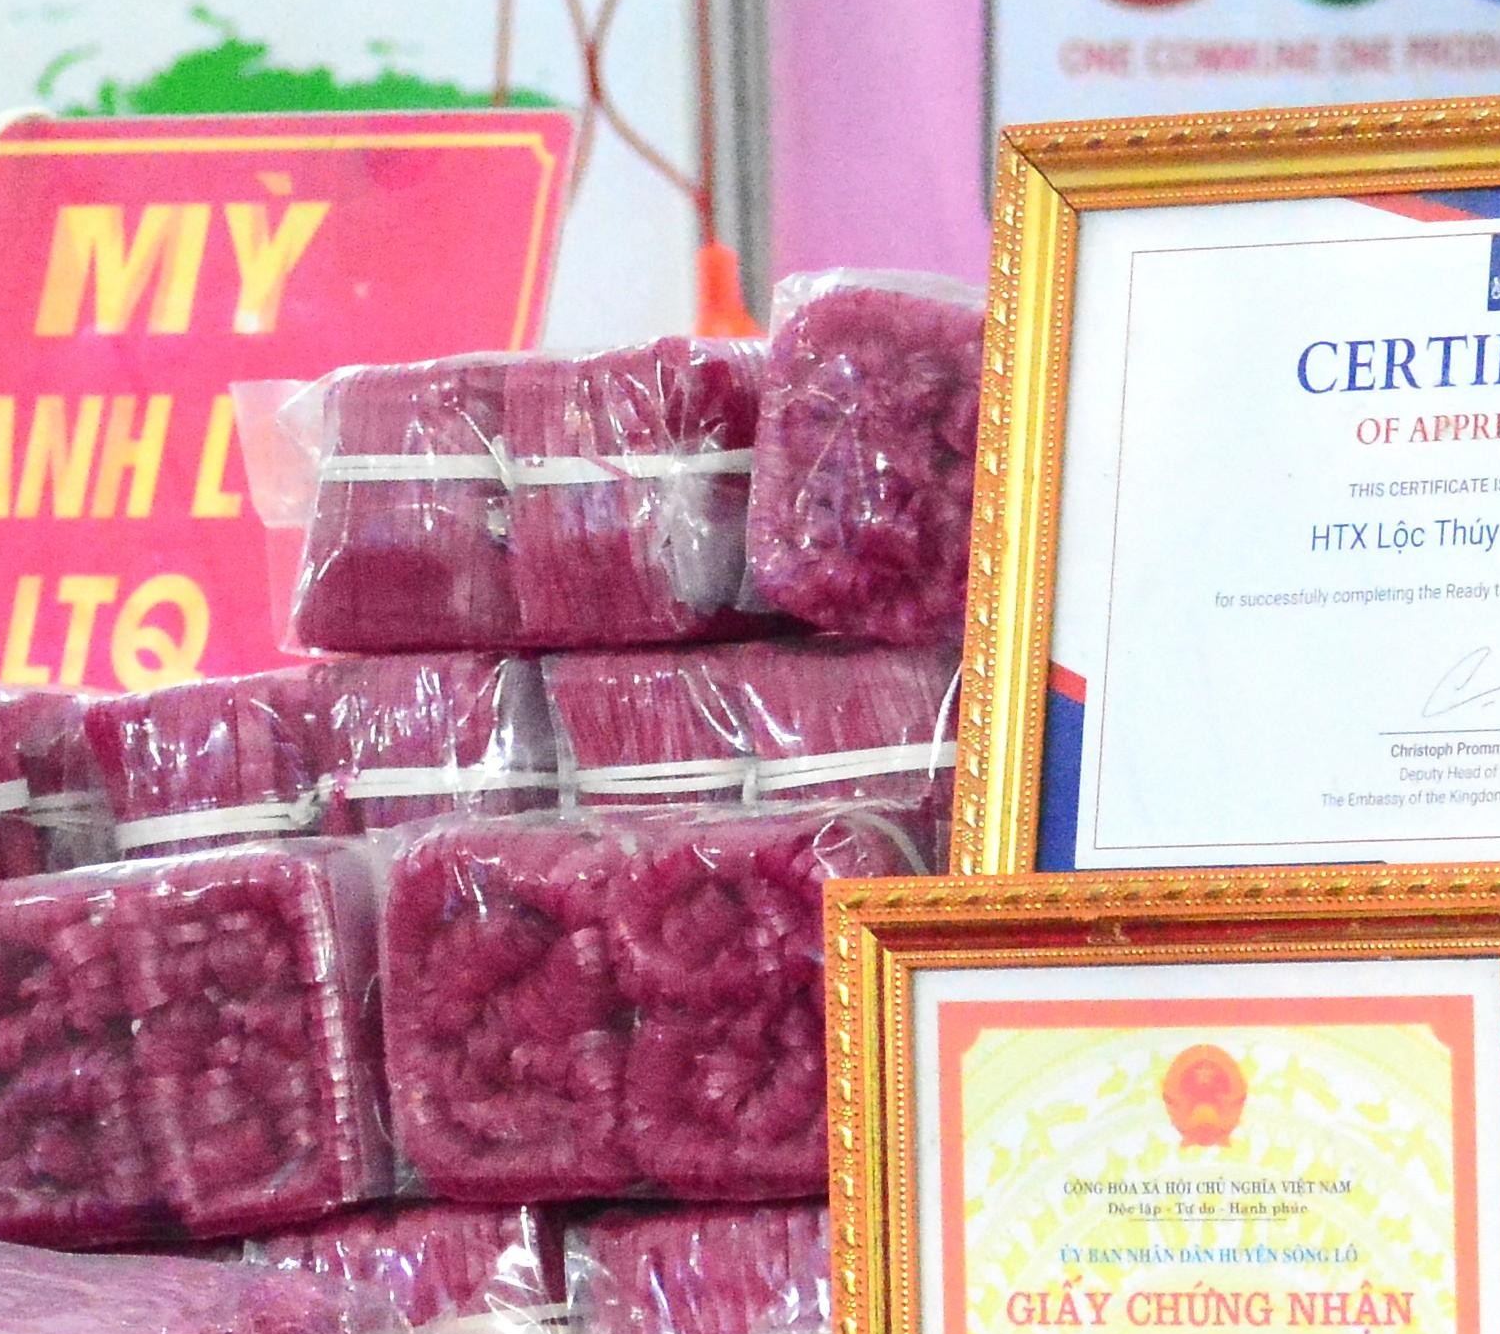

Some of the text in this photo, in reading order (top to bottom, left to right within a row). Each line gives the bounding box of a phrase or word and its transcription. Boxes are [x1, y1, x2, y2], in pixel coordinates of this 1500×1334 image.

[1356, 417, 1400, 446] OF
[1349, 482, 1385, 498] THIS
[1388, 478, 1489, 497] CERTIFICATE
[1310, 522, 1369, 552] HTX
[1377, 520, 1425, 555] Lộc
[1434, 517, 1500, 554] Thúy
[1214, 591, 1235, 608] for
[1239, 587, 1329, 607] successfully
[1333, 585, 1414, 605] completing
[1418, 584, 1441, 600] the
[1446, 582, 1490, 601] Ready
[1, 573, 211, 689] LTQ
[1390, 742, 1454, 759] Christoph
[1006, 1275, 1113, 1327] GIẤY
[1126, 1280, 1274, 1327] CHỨNG
